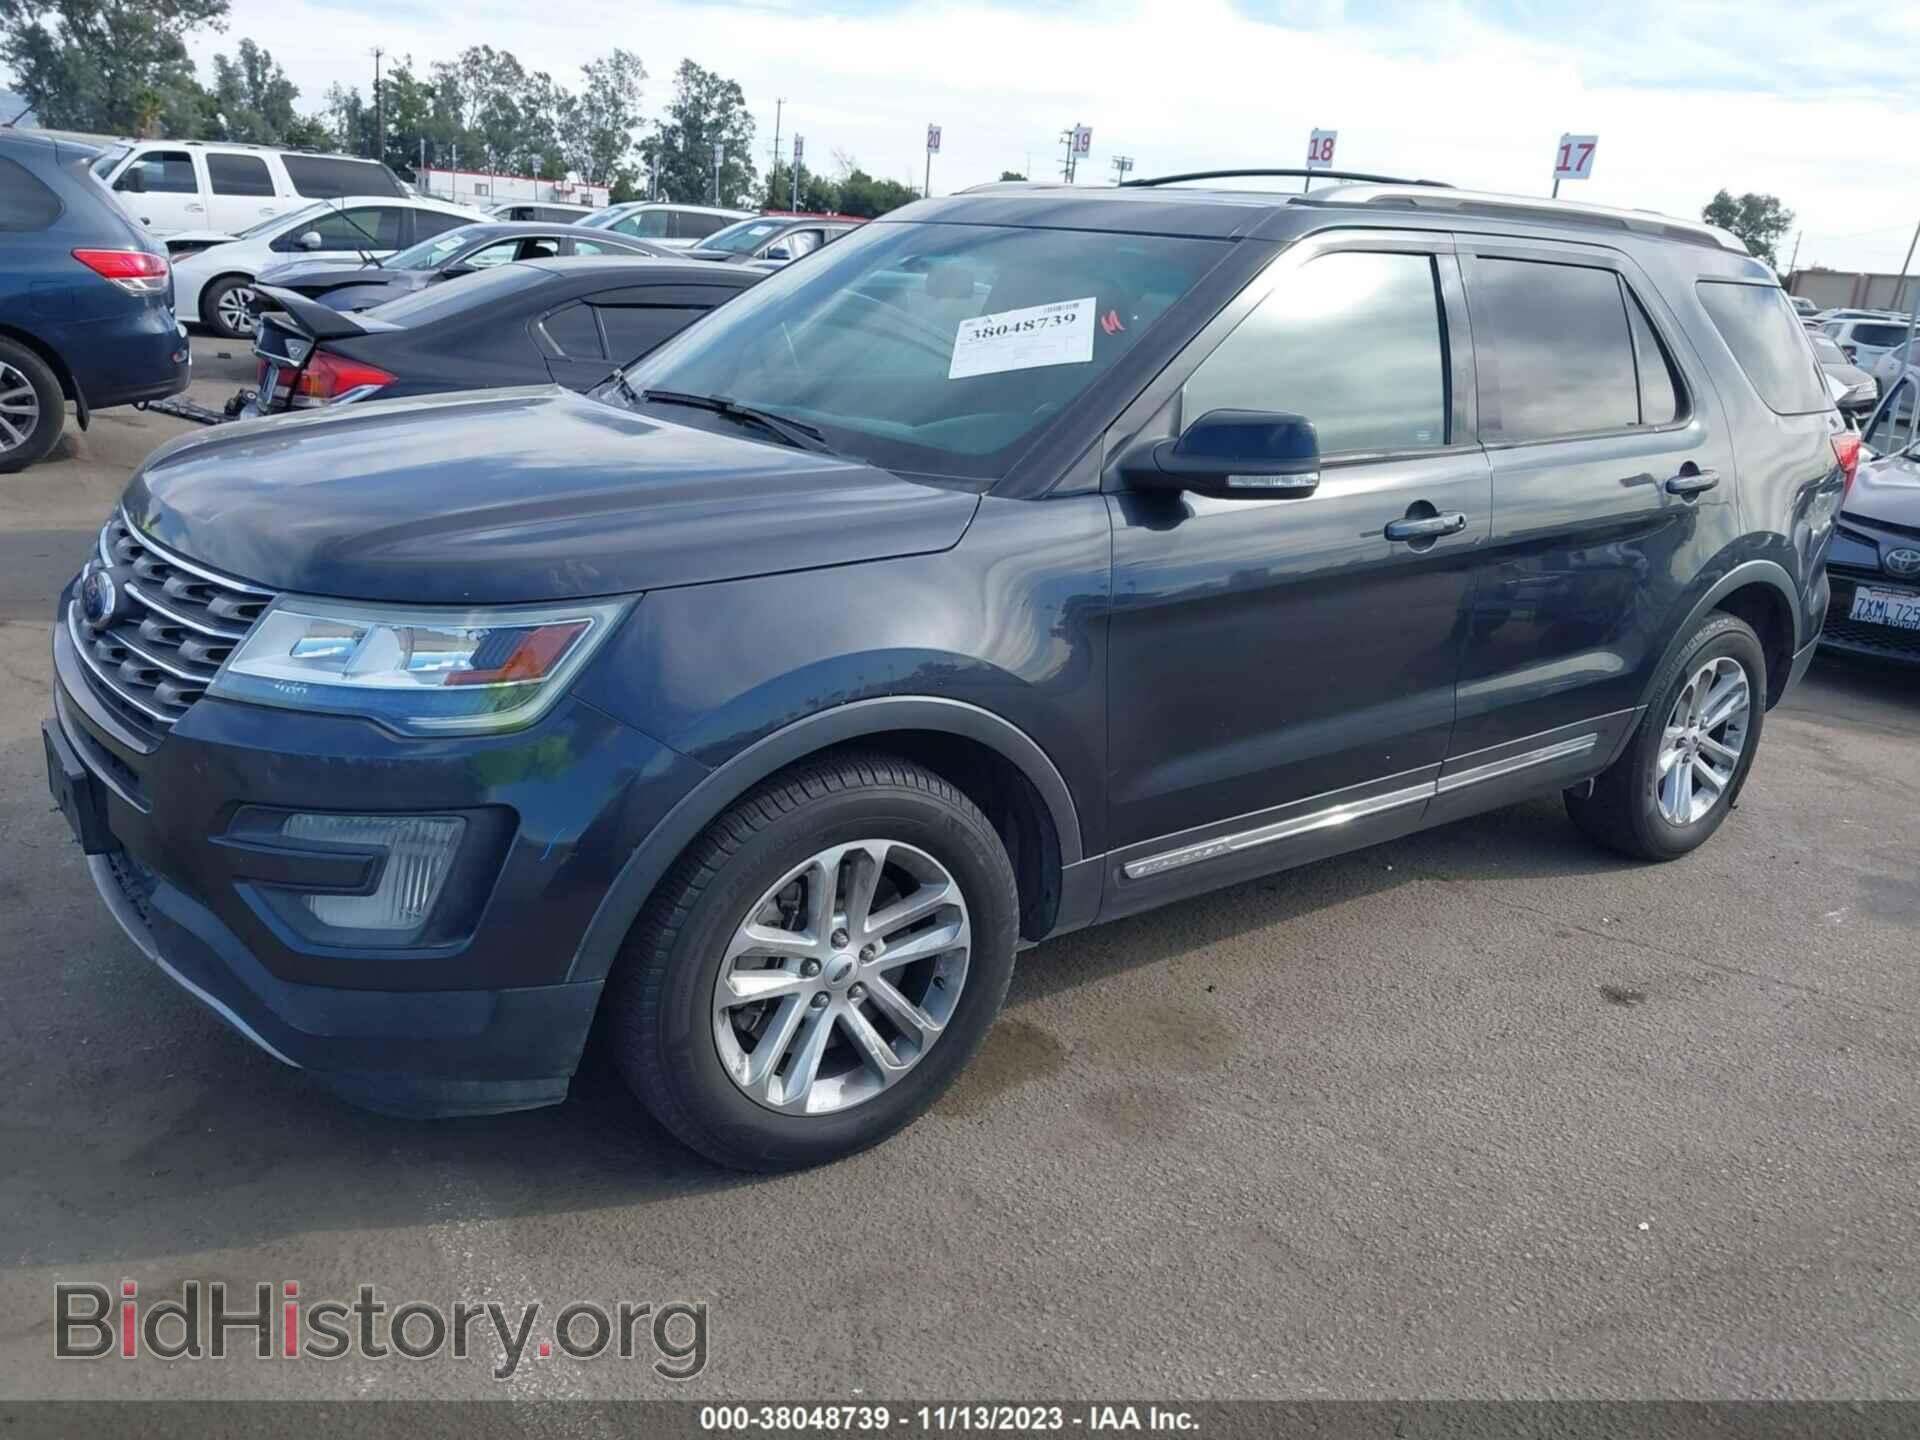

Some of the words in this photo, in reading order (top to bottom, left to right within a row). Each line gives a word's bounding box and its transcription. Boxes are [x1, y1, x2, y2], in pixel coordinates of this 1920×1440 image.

[928, 131, 941, 149] 20
[1074, 133, 1091, 152] 19
[1308, 138, 1335, 161] 18
[1555, 143, 1596, 171] 17
[969, 312, 1077, 342] 38048739
